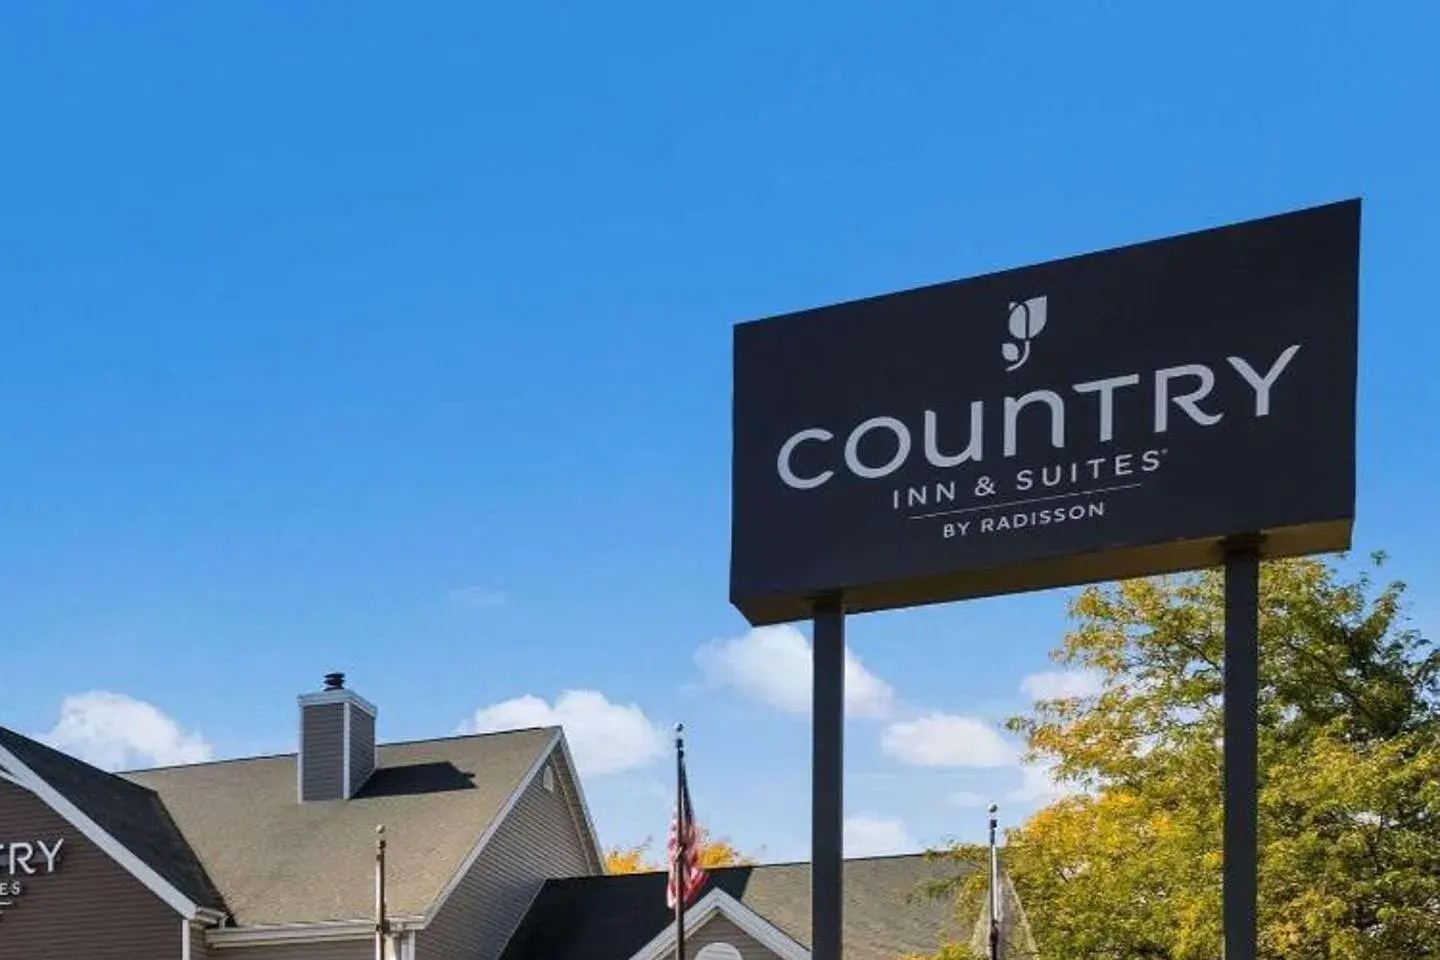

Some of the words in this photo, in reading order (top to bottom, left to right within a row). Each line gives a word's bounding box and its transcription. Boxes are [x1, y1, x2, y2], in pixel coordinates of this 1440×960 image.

[892, 480, 957, 510] INN
[974, 475, 997, 498] &
[1015, 449, 1162, 492] SUITES
[943, 521, 971, 539] BY
[979, 501, 1106, 535] RADISSON
